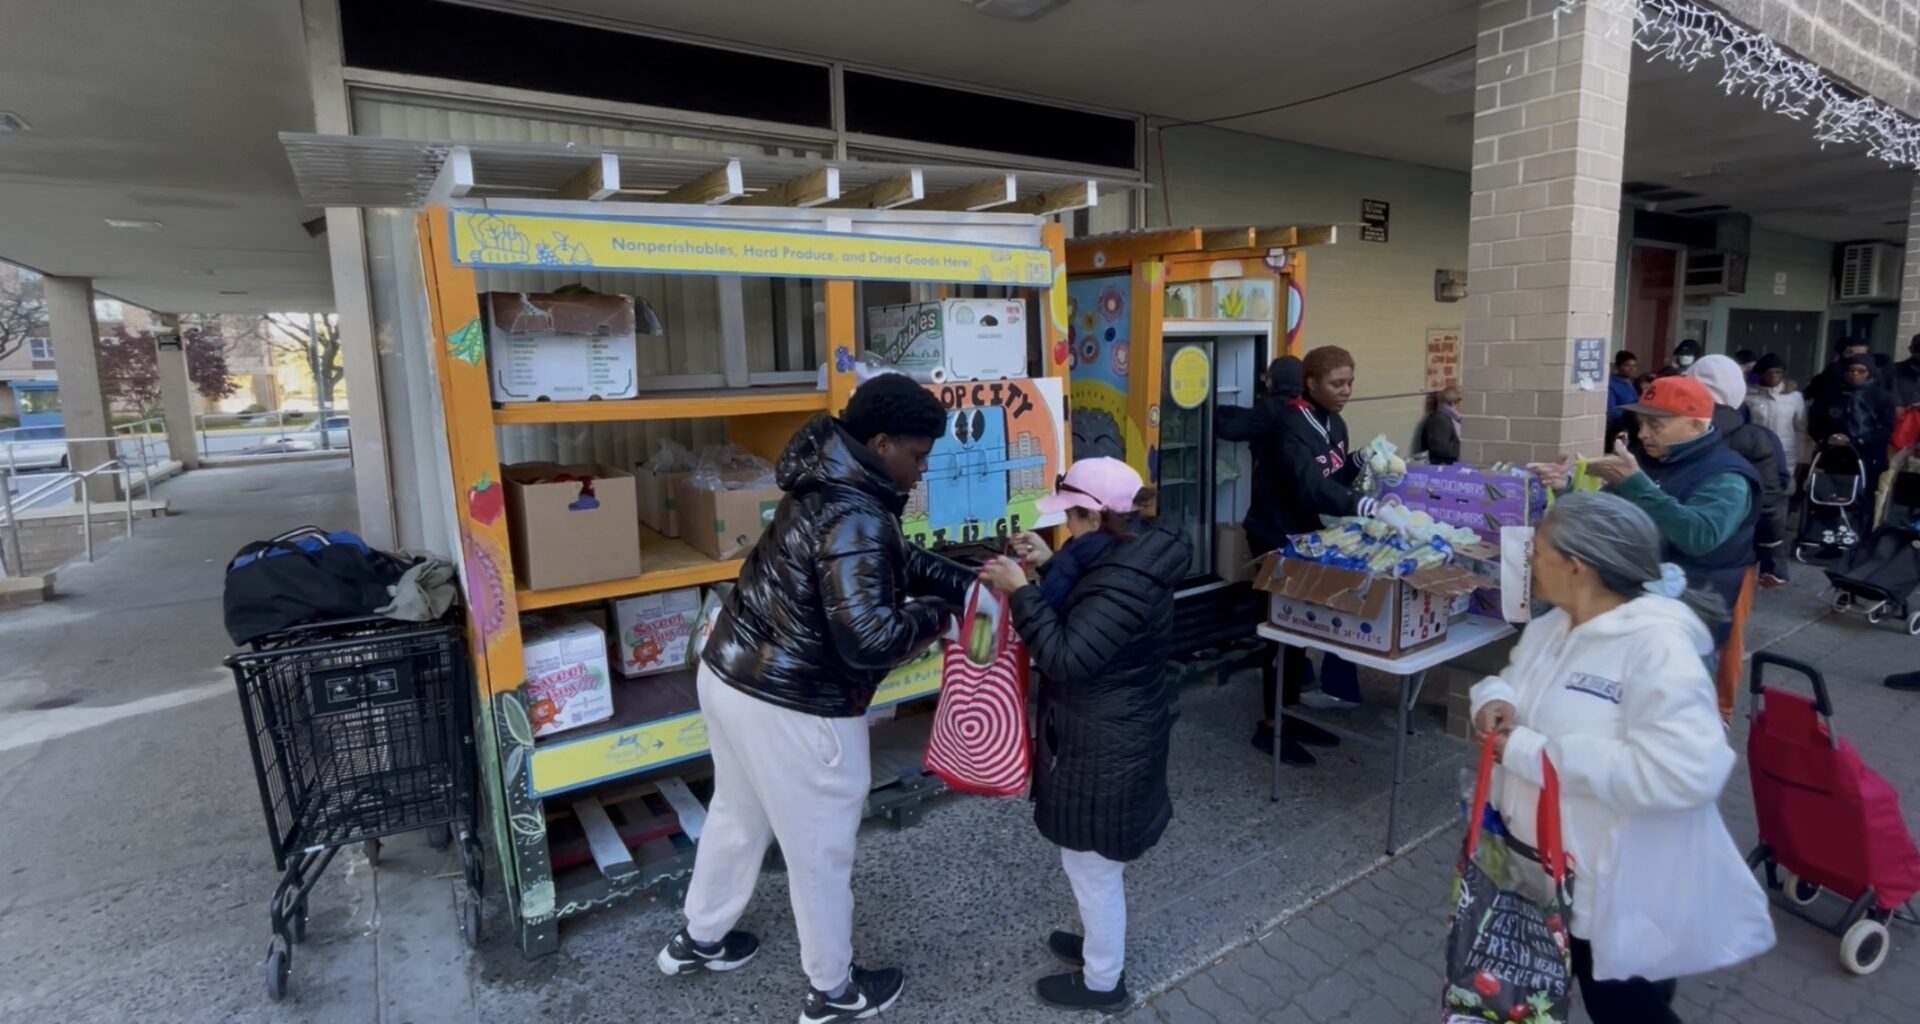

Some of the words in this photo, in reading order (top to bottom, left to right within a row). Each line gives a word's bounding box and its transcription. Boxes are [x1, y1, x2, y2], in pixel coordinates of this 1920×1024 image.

[611, 236, 739, 257] Nonperishables,
[743, 244, 778, 259] Hard
[782, 248, 838, 263] Produce,
[842, 252, 865, 264] and
[869, 251, 901, 265] Dried
[904, 253, 940, 267] Goods
[943, 256, 972, 268] Here!
[971, 382, 1033, 419] CITY
[1441, 478, 1486, 497] CUCUMBERS
[904, 514, 1021, 551] RIDGE
[1439, 507, 1485, 526] CUCUMBERS
[634, 613, 684, 640] Sweet
[1473, 934, 1531, 967] FRESH
